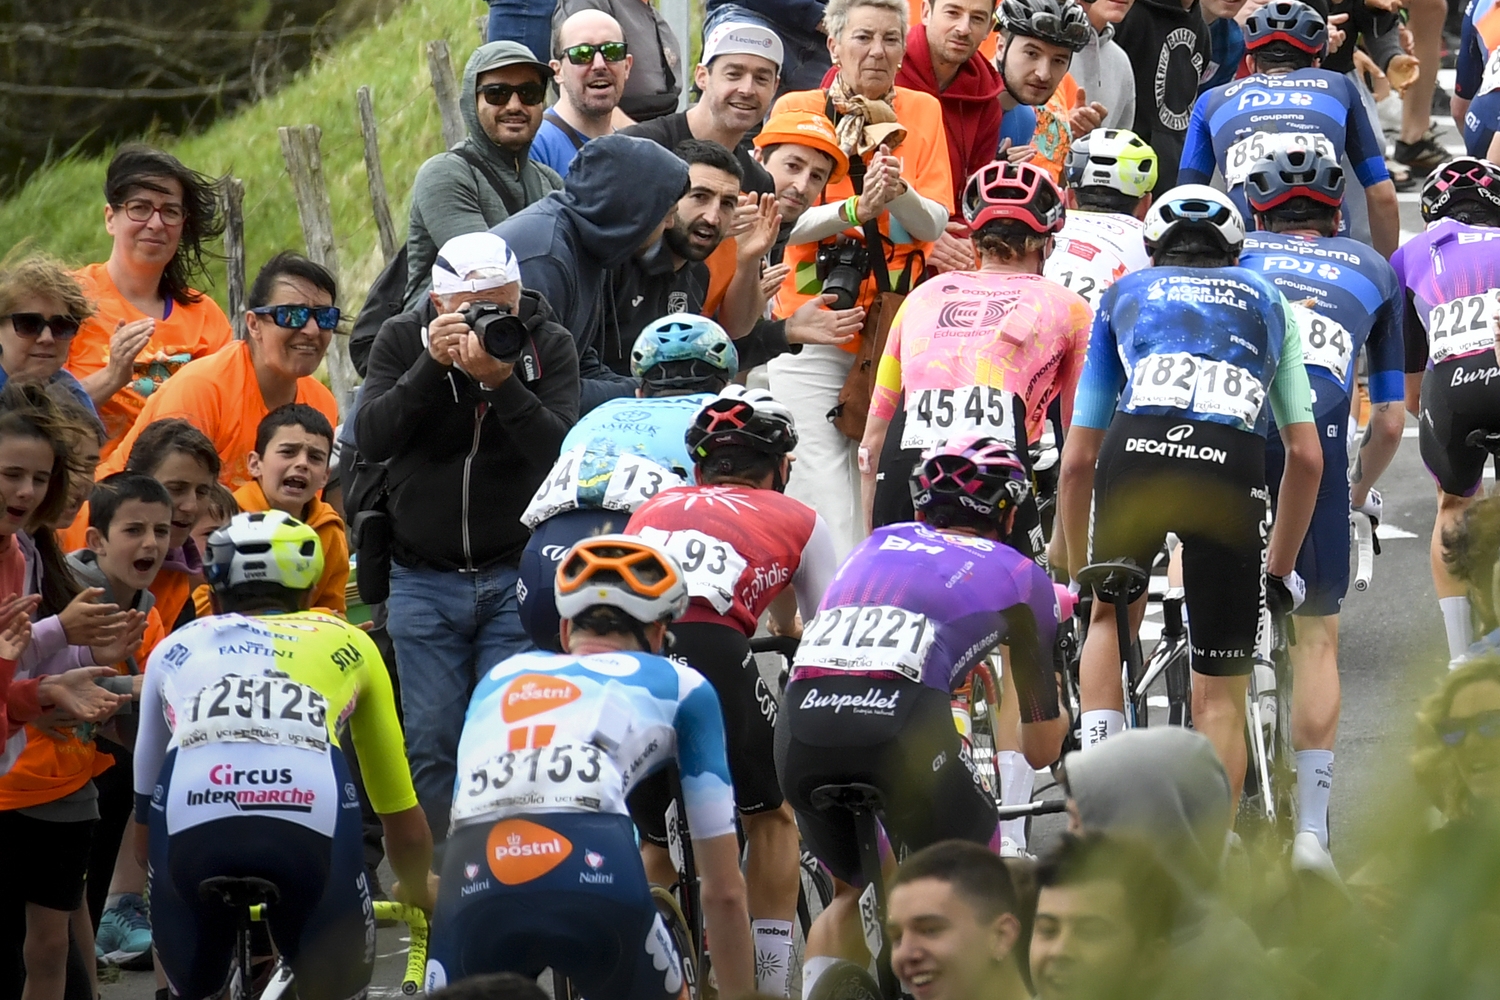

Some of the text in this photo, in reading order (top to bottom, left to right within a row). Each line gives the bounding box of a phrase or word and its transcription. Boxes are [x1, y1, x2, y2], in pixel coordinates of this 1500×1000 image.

[1224, 73, 1329, 98] Groupama
[1237, 90, 1283, 112] FDJ
[1250, 113, 1305, 123] Groupama
[1232, 134, 1266, 168] 85
[1243, 239, 1361, 265] Groupama
[1263, 256, 1315, 273] FDJ
[961, 287, 1022, 298] easypost
[1214, 287, 1236, 299] LA
[1274, 277, 1328, 297] Groupama
[1166, 293, 1248, 311] MONDIALE
[1432, 297, 1488, 341] 222
[933, 328, 996, 340] Education
[1308, 319, 1346, 357] 84
[523, 354, 535, 382] Canon
[1024, 348, 1065, 402] cannondale
[1135, 356, 1198, 391] 182
[915, 386, 1005, 428] 45 45
[1125, 438, 1227, 465] DECATHLON
[682, 538, 728, 576] 93
[879, 535, 946, 555] BH
[856, 607, 927, 654] 221
[218, 644, 295, 660] FANTINI
[1209, 648, 1245, 659] RYSEL
[190, 676, 326, 729] 125 125
[507, 684, 572, 711] postnl
[799, 687, 900, 714] Burpellet
[209, 763, 293, 785] Circus
[523, 744, 602, 784] 153
[495, 838, 561, 861] postnl
[460, 870, 614, 897] Nalini Nalini
[756, 925, 790, 937] mobel
